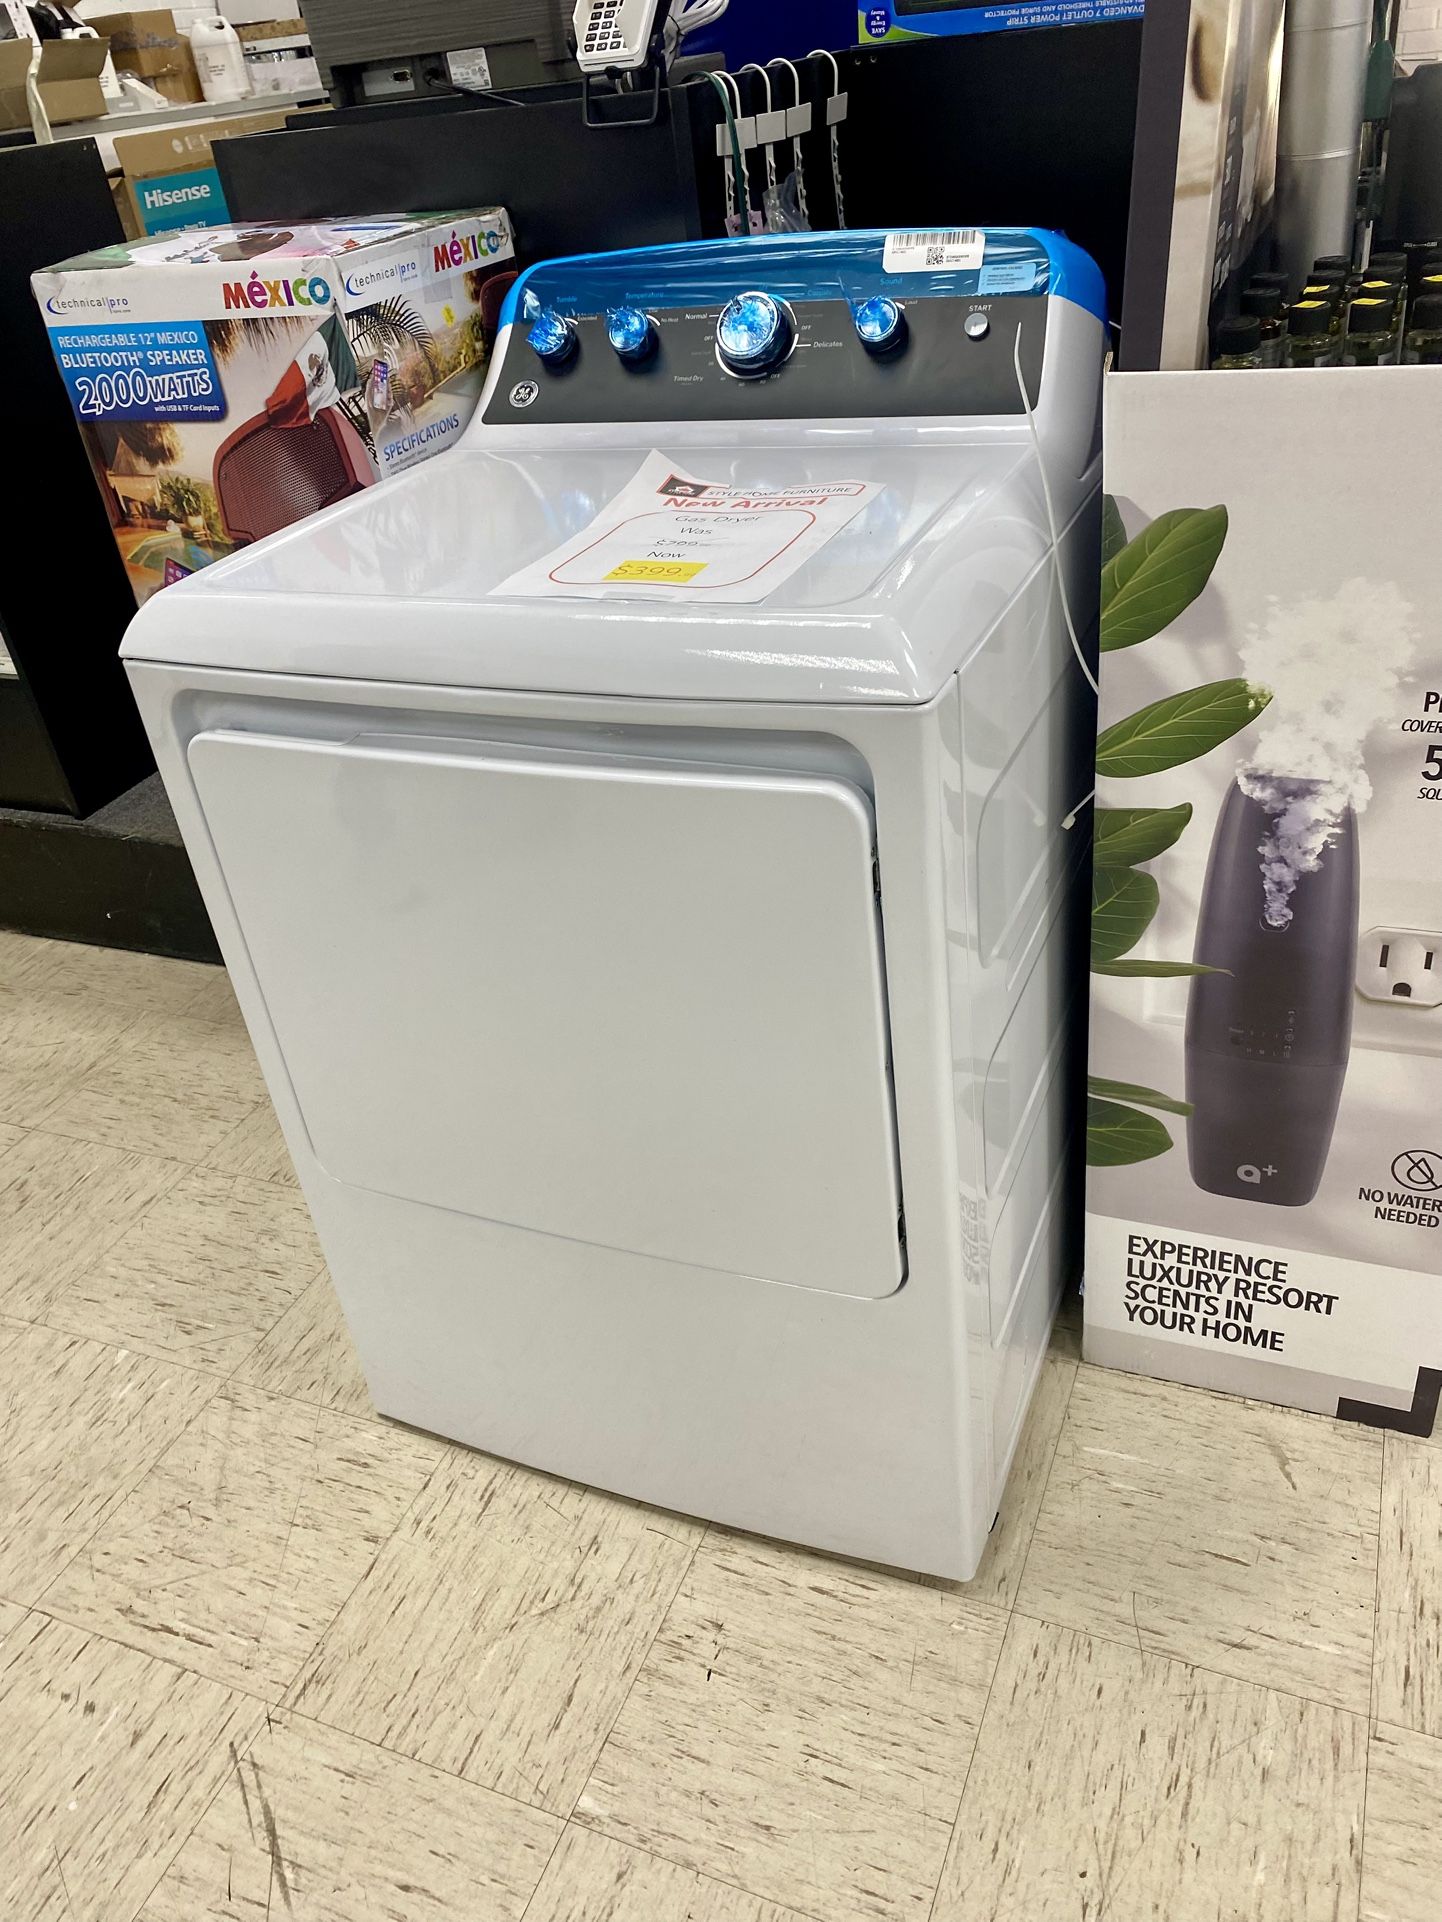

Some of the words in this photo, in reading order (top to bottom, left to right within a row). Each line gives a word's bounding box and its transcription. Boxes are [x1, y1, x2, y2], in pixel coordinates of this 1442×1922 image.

[1057, 2, 1093, 11] THRESHOLD
[1103, 4, 1145, 16] DVANCED
[985, 9, 1020, 18] PROTECTOR
[1031, 13, 1061, 23] POWER
[1062, 10, 1095, 20] OUTLET
[1096, 9, 1101, 17] 7
[1007, 17, 1028, 25] STRIP
[144, 184, 211, 209] Hisense
[354, 264, 398, 288] technical
[400, 261, 416, 276] pro
[880, 277, 903, 286] Sound
[57, 297, 106, 309] technical
[109, 298, 128, 309] pro
[968, 304, 992, 312] START
[58, 333, 136, 348] RECHARGEABLE
[157, 330, 198, 345] MEXICO
[148, 350, 208, 366] SPEAKER
[384, 413, 460, 462] SPECIFICATIONS
[662, 498, 726, 507] New
[730, 497, 828, 508] Arrival
[713, 515, 762, 523] Dryer
[680, 527, 713, 535] Was
[1358, 1187, 1384, 1203] NO
[1387, 1192, 1442, 1213] WATER
[1374, 1206, 1440, 1228] NEEDED
[1127, 1234, 1289, 1283] EXPERIENCE
[1127, 1258, 1230, 1295] LUXURY
[1234, 1278, 1339, 1316] RESORT
[1125, 1281, 1219, 1316] SCENTS
[1225, 1299, 1253, 1324] IN
[1123, 1302, 1195, 1334] YOUR
[1201, 1318, 1285, 1352] HOME
